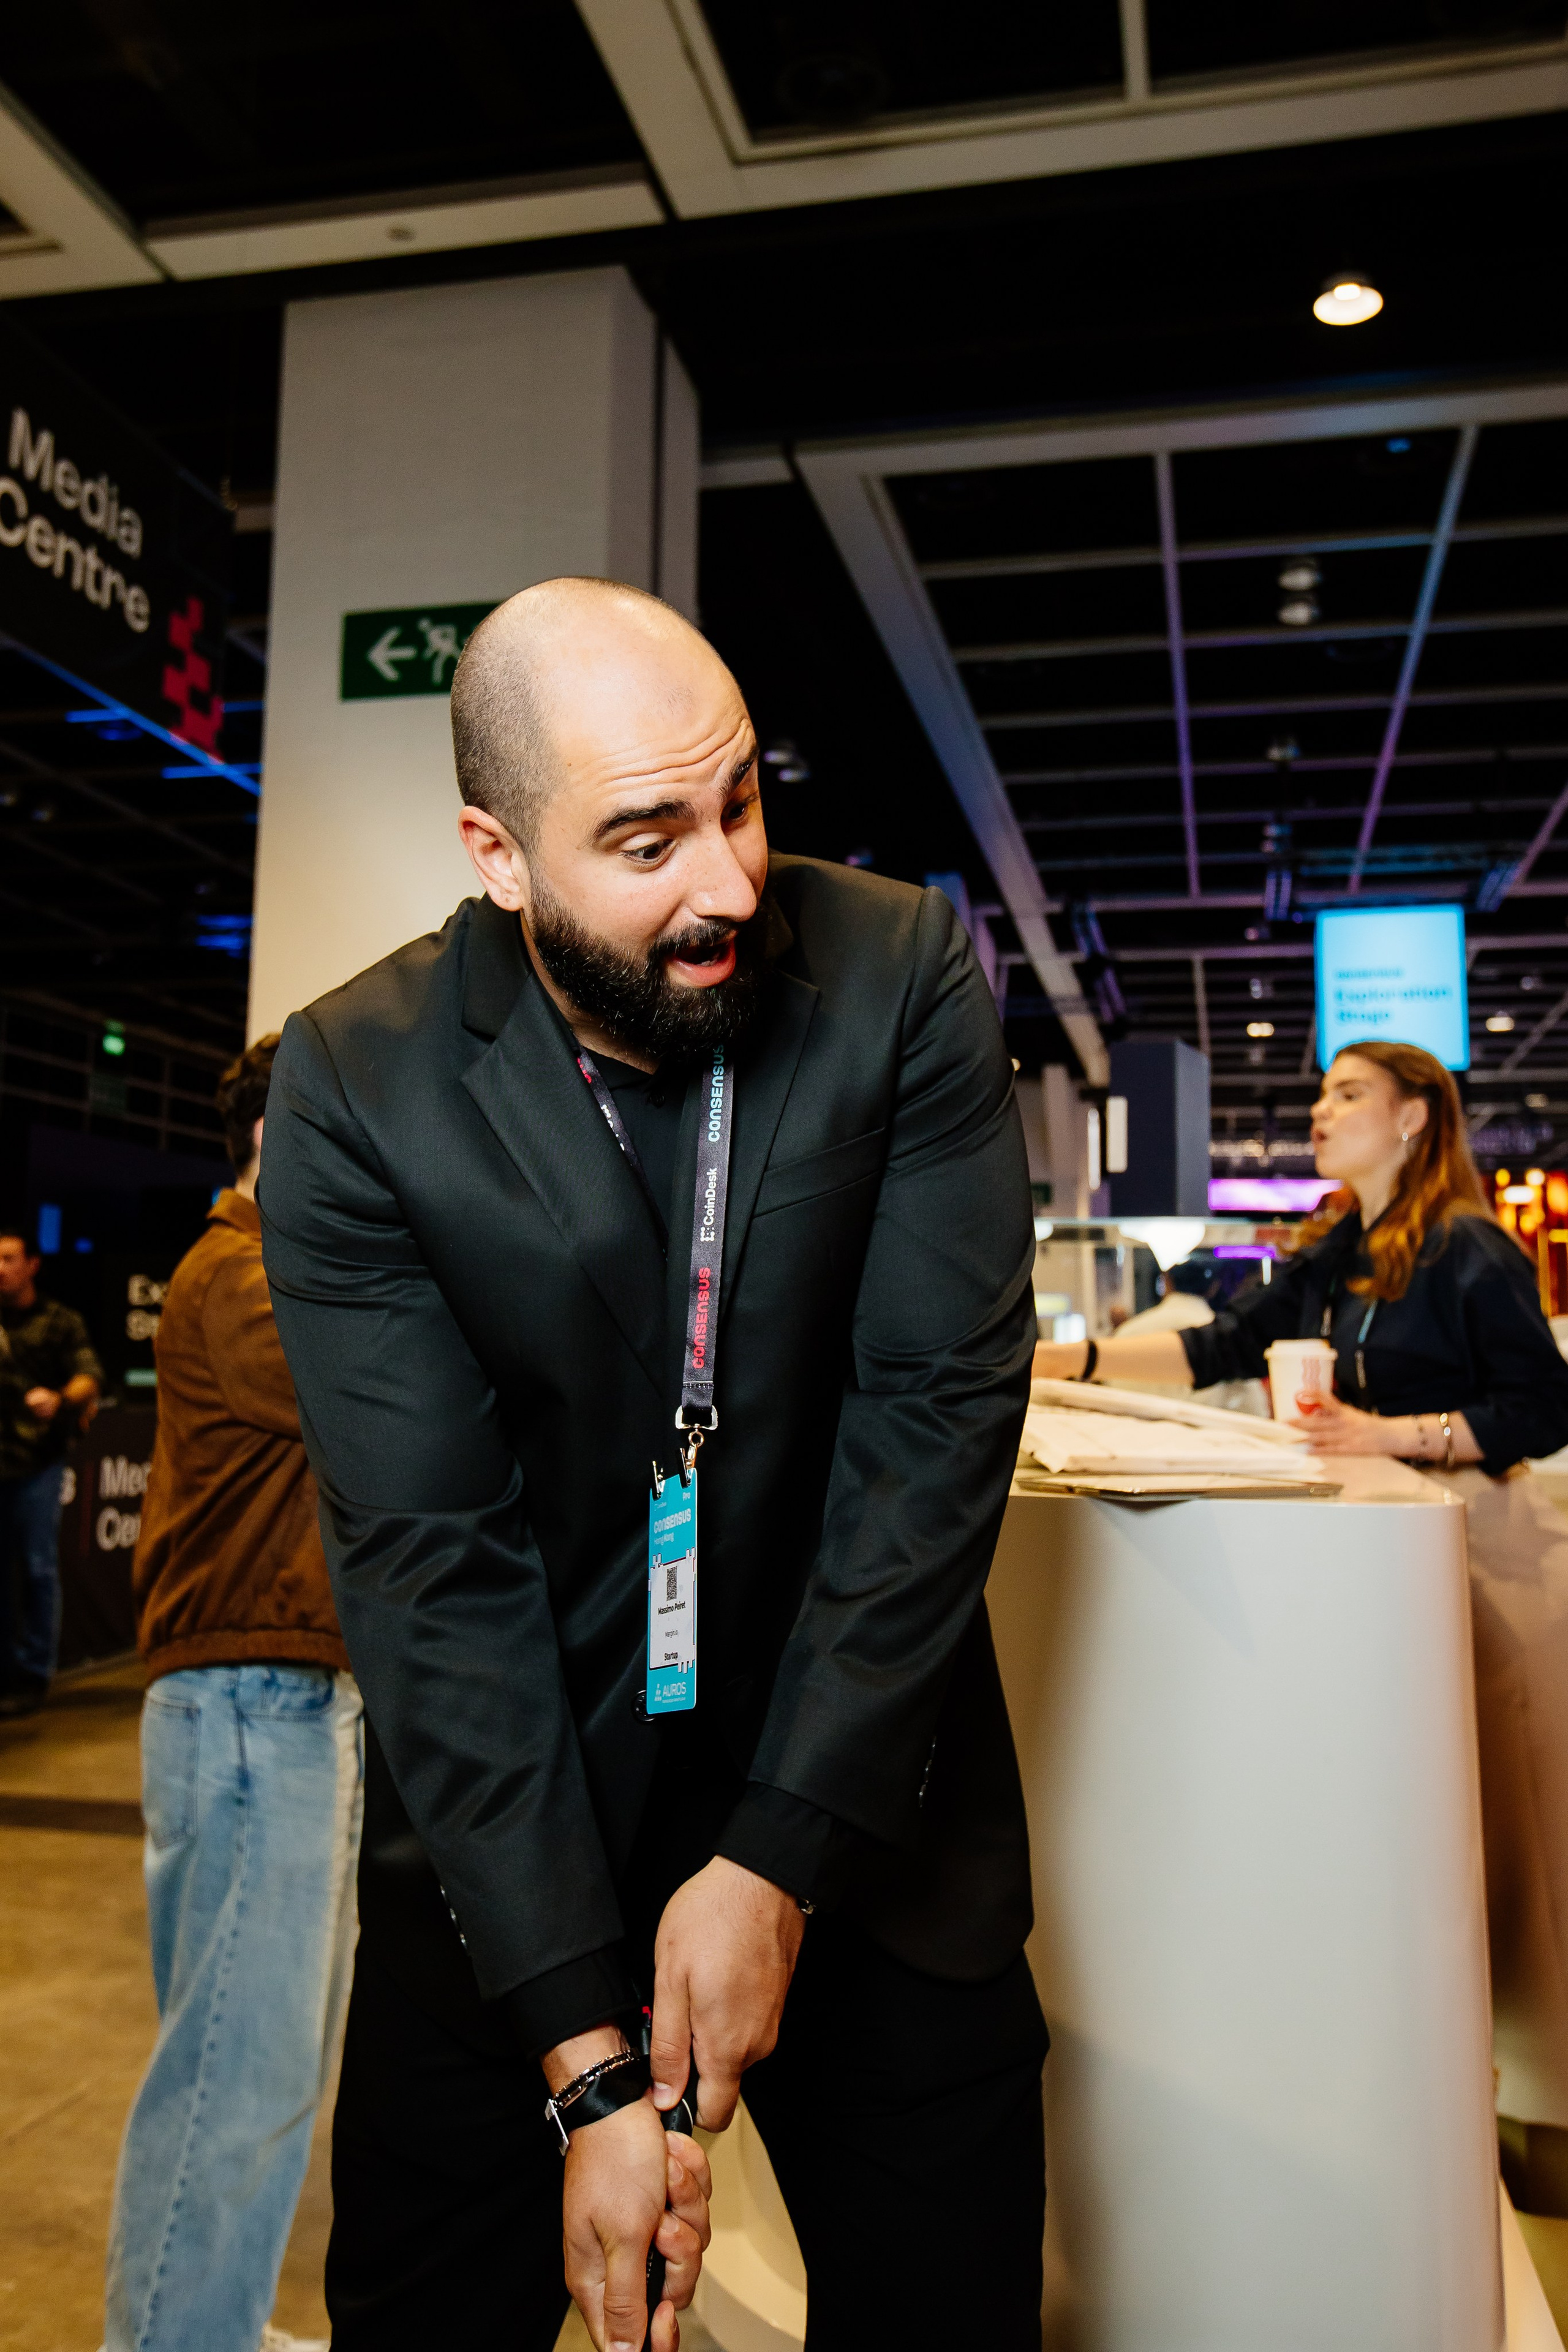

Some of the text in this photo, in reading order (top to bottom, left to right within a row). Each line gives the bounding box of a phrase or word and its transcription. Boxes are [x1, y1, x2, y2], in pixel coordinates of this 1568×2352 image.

[8, 407, 143, 559] Media
[0, 475, 151, 633] Centre
[703, 1167, 717, 1226] CoinDesk
[664, 1652, 678, 1660] Startup
[662, 1681, 687, 1697] AUROS
